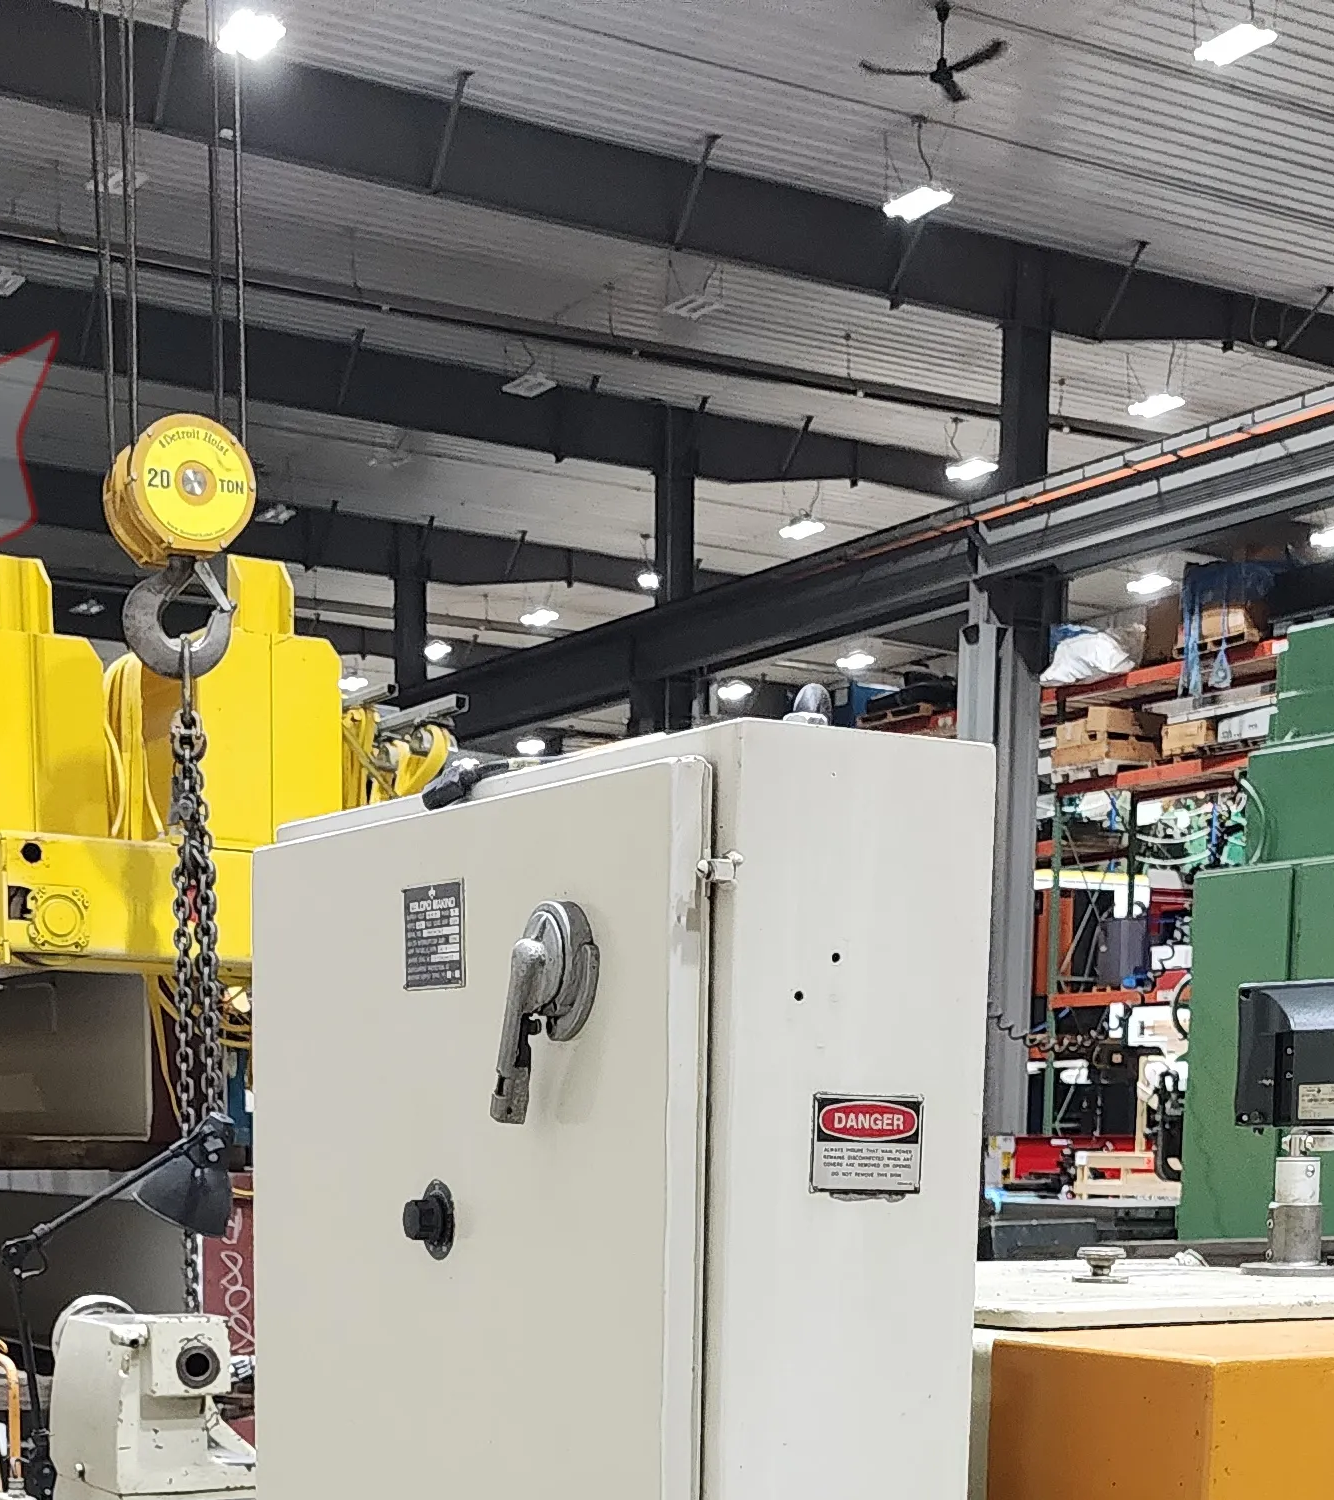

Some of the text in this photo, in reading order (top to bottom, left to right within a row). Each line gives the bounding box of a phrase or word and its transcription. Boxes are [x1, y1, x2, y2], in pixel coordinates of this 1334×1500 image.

[147, 468, 244, 494] 20 TON
[833, 1112, 904, 1130] DANGER
